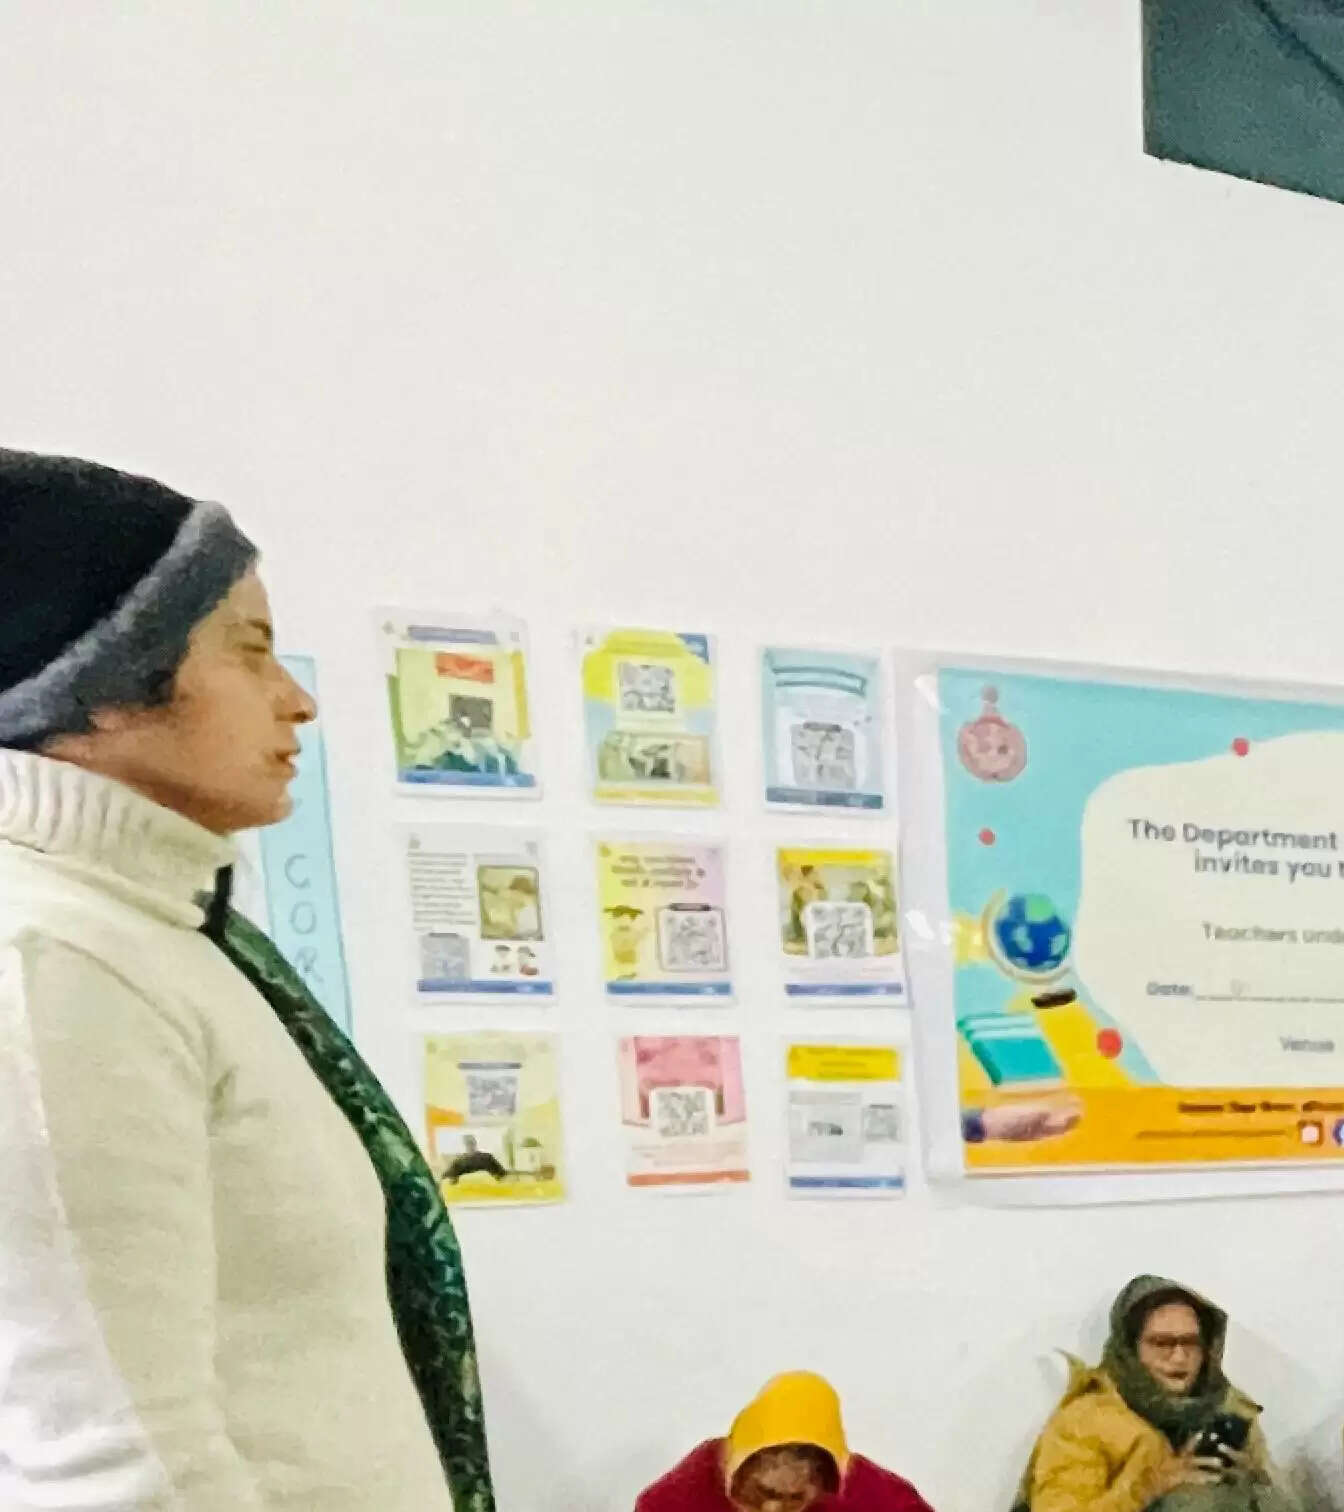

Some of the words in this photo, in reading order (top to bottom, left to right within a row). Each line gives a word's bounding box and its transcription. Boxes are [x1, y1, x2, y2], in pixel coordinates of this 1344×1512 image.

[1128, 818, 1176, 843] The
[1183, 822, 1337, 851] Department
[1286, 861, 1332, 884] you
